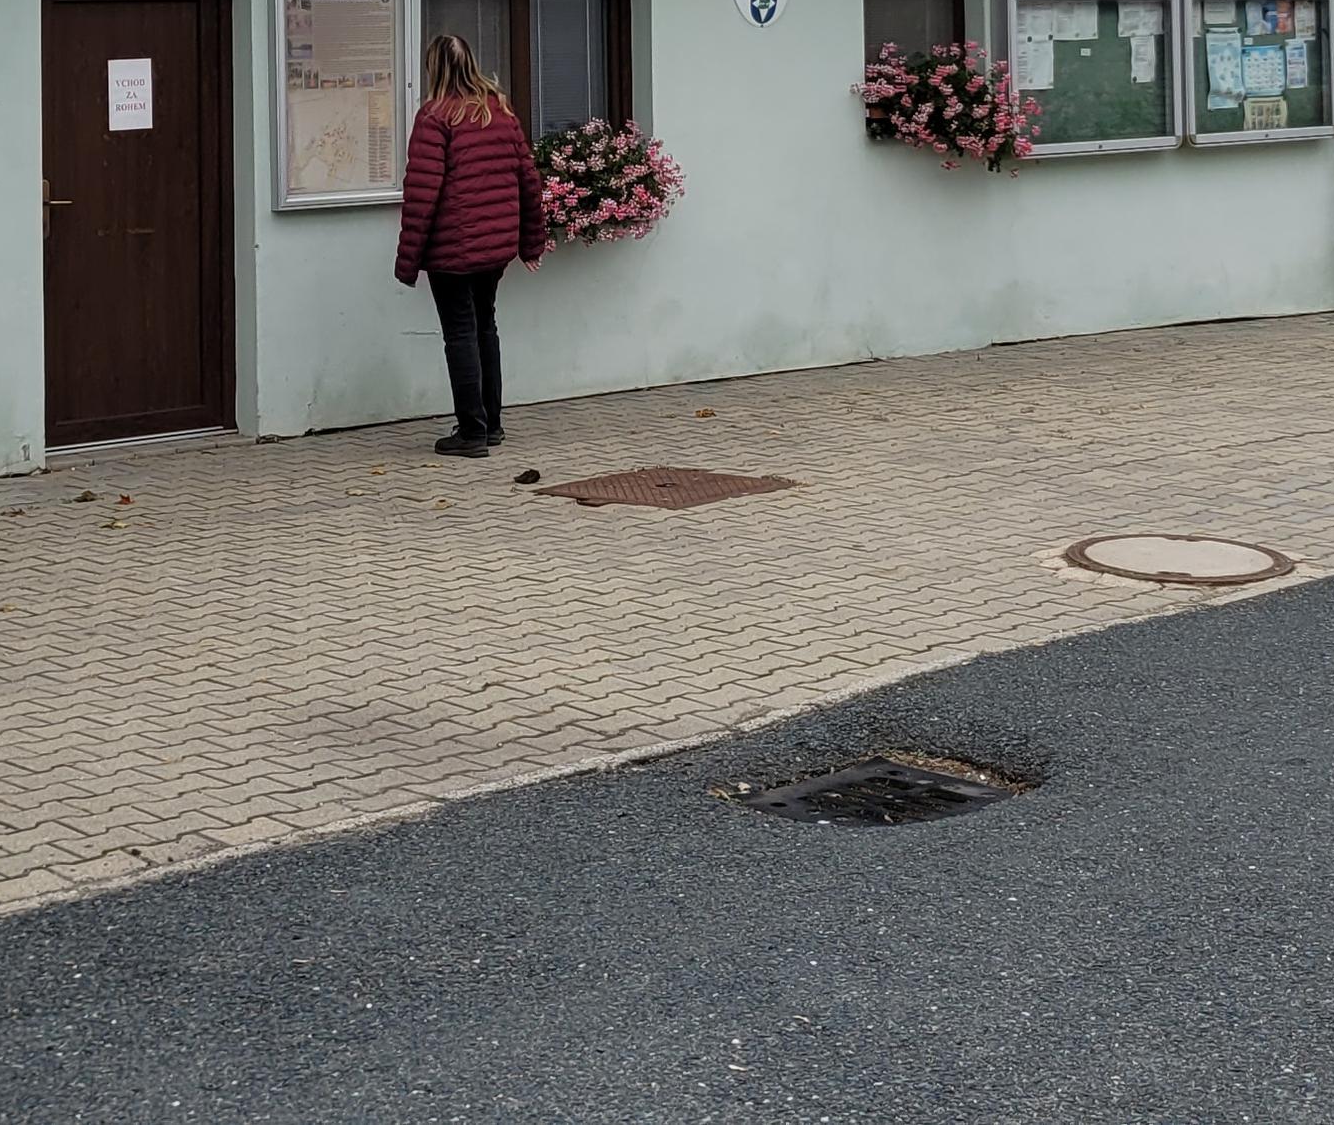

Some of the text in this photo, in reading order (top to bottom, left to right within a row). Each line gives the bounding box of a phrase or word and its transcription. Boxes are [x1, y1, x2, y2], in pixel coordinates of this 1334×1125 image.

[115, 79, 145, 87] VCHOD
[126, 91, 138, 99] ZA
[115, 102, 146, 111] ROHEM
